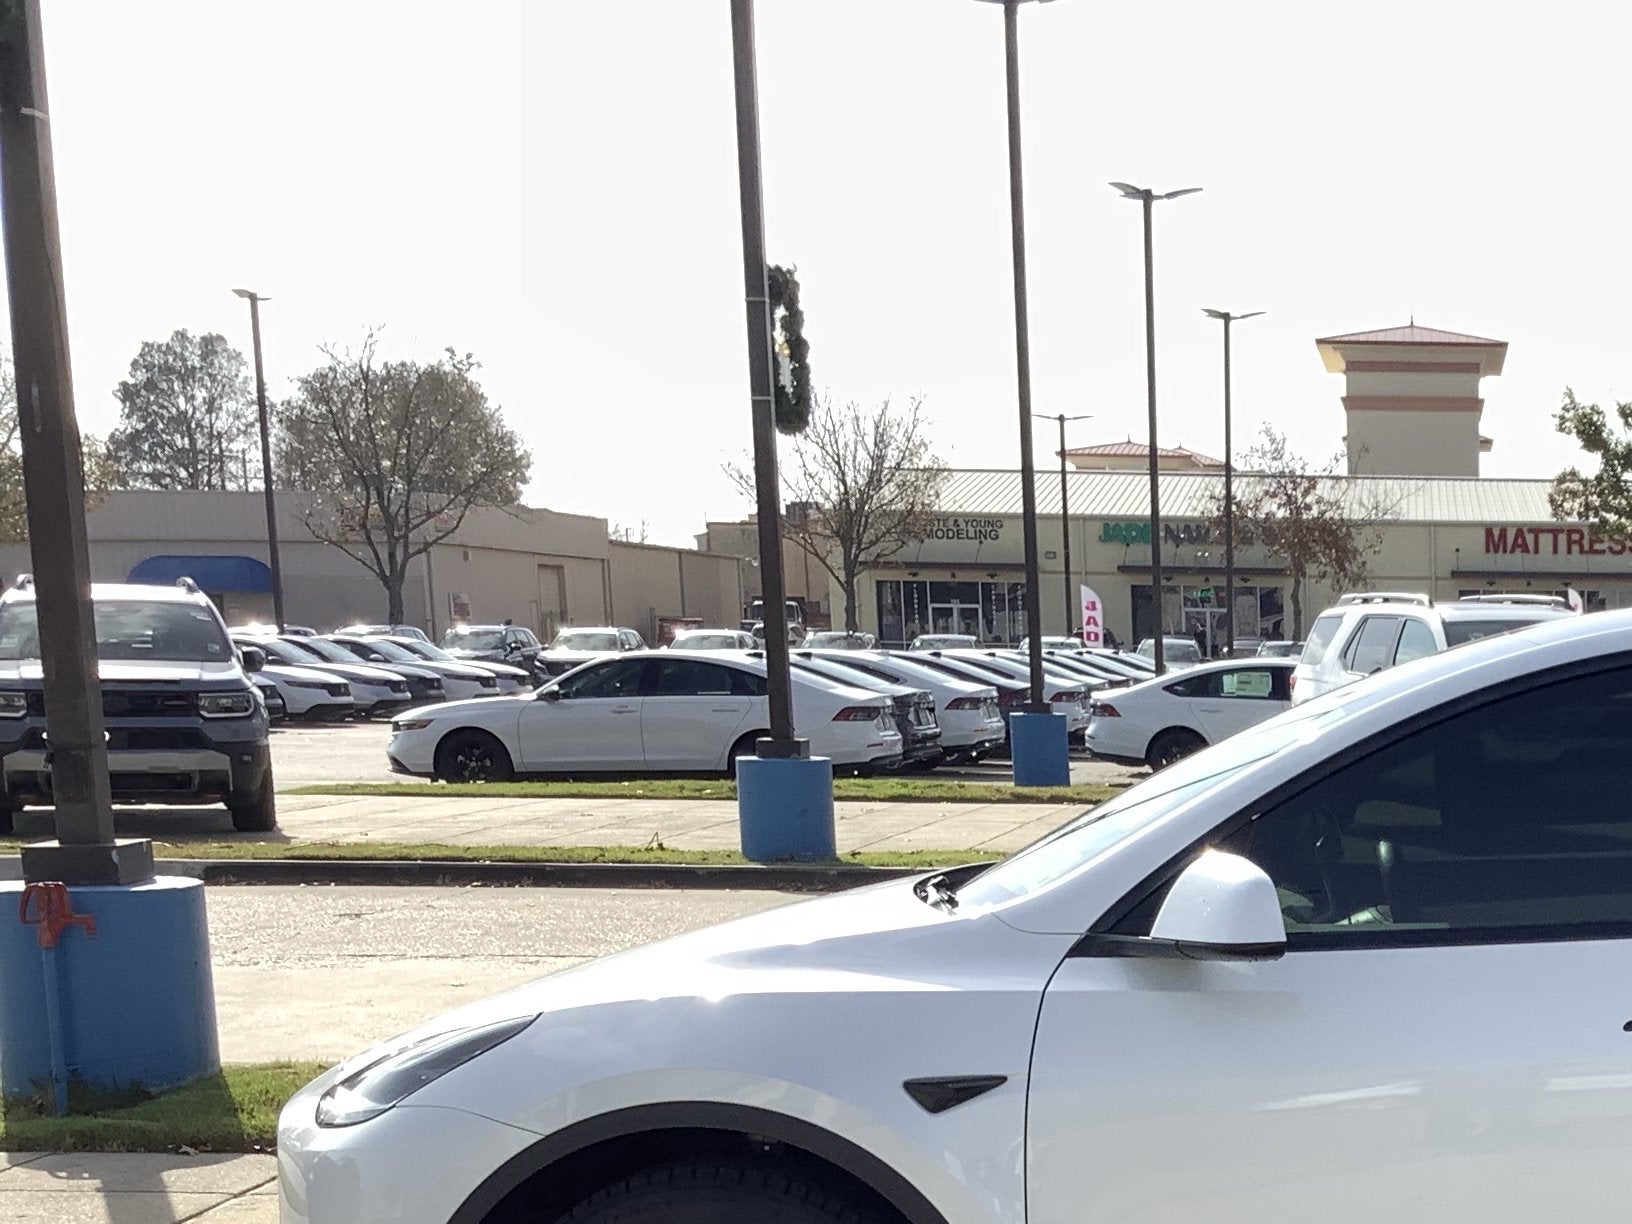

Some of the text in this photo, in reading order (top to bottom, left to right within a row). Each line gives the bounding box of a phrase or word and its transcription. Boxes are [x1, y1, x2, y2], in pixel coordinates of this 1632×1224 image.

[928, 518, 1004, 529] STE & YOUNG
[926, 528, 999, 541] MODELING
